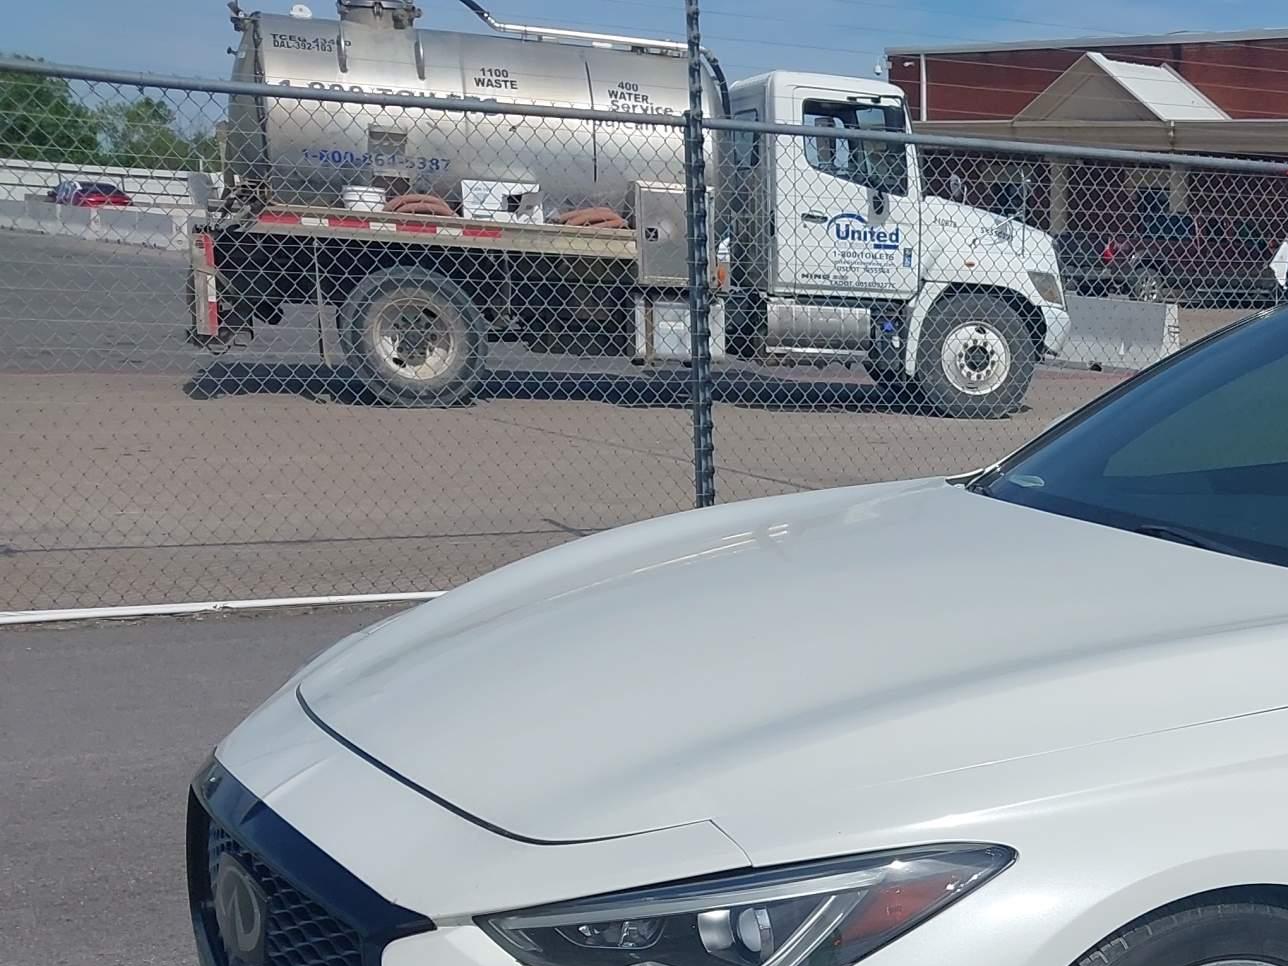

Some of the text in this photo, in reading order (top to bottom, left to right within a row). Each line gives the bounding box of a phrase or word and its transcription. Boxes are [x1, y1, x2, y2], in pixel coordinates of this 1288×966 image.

[480, 67, 509, 78] 1100
[474, 77, 518, 90] WASTE
[618, 81, 639, 92] 400
[608, 90, 649, 104] WATER
[610, 100, 674, 116] Service
[835, 223, 899, 243] United
